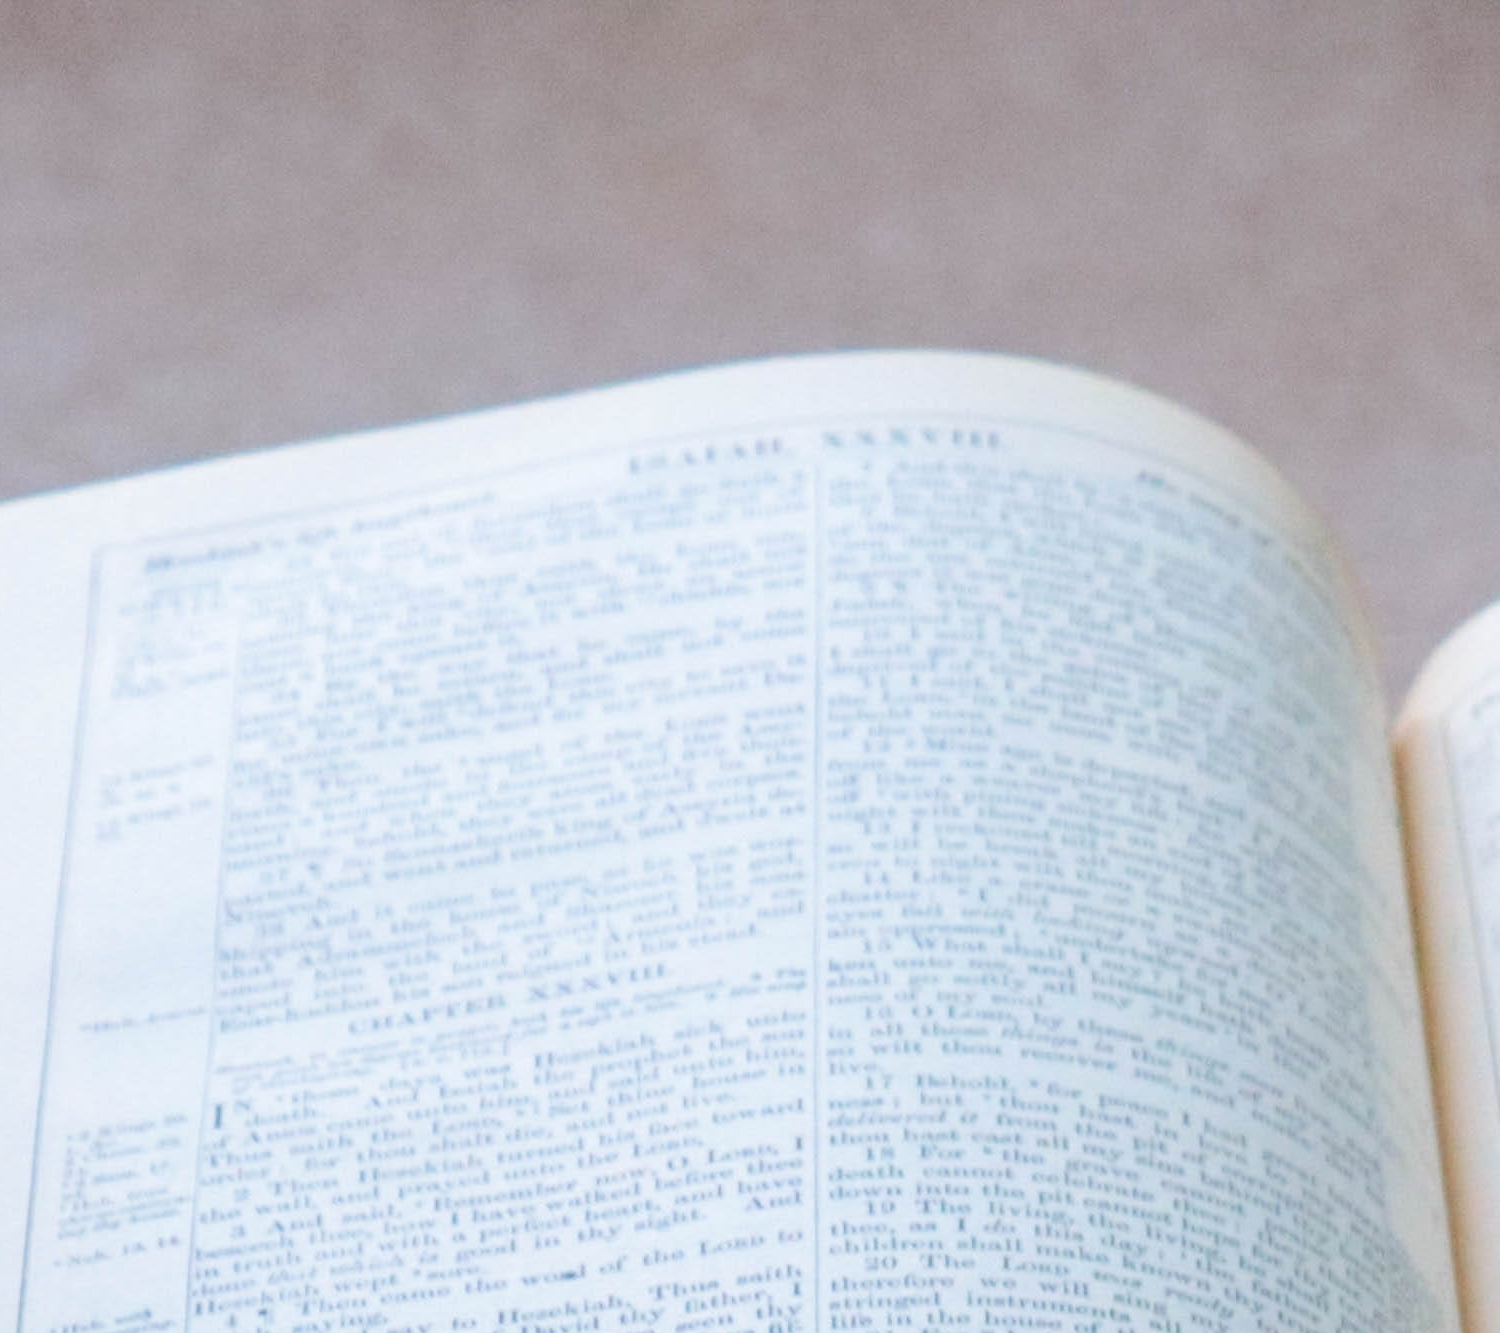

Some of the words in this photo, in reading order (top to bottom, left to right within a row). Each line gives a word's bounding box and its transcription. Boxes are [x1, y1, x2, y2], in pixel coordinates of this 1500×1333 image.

[452, 1317, 477, 1331] to
[648, 1279, 720, 1301] Thus
[736, 1264, 803, 1286] saith
[831, 1275, 954, 1292] therefore
[980, 1277, 1016, 1289] we
[1039, 1281, 1090, 1297] will
[619, 1304, 666, 1325] thy
[675, 1314, 734, 1333] seen
[756, 1302, 803, 1322] thy
[829, 1293, 941, 1310] stringed
[967, 1292, 1131, 1322] instruments
[831, 1314, 872, 1329] life
[887, 1313, 912, 1326] in
[928, 1312, 970, 1325] the
[985, 1312, 1061, 1330] house
